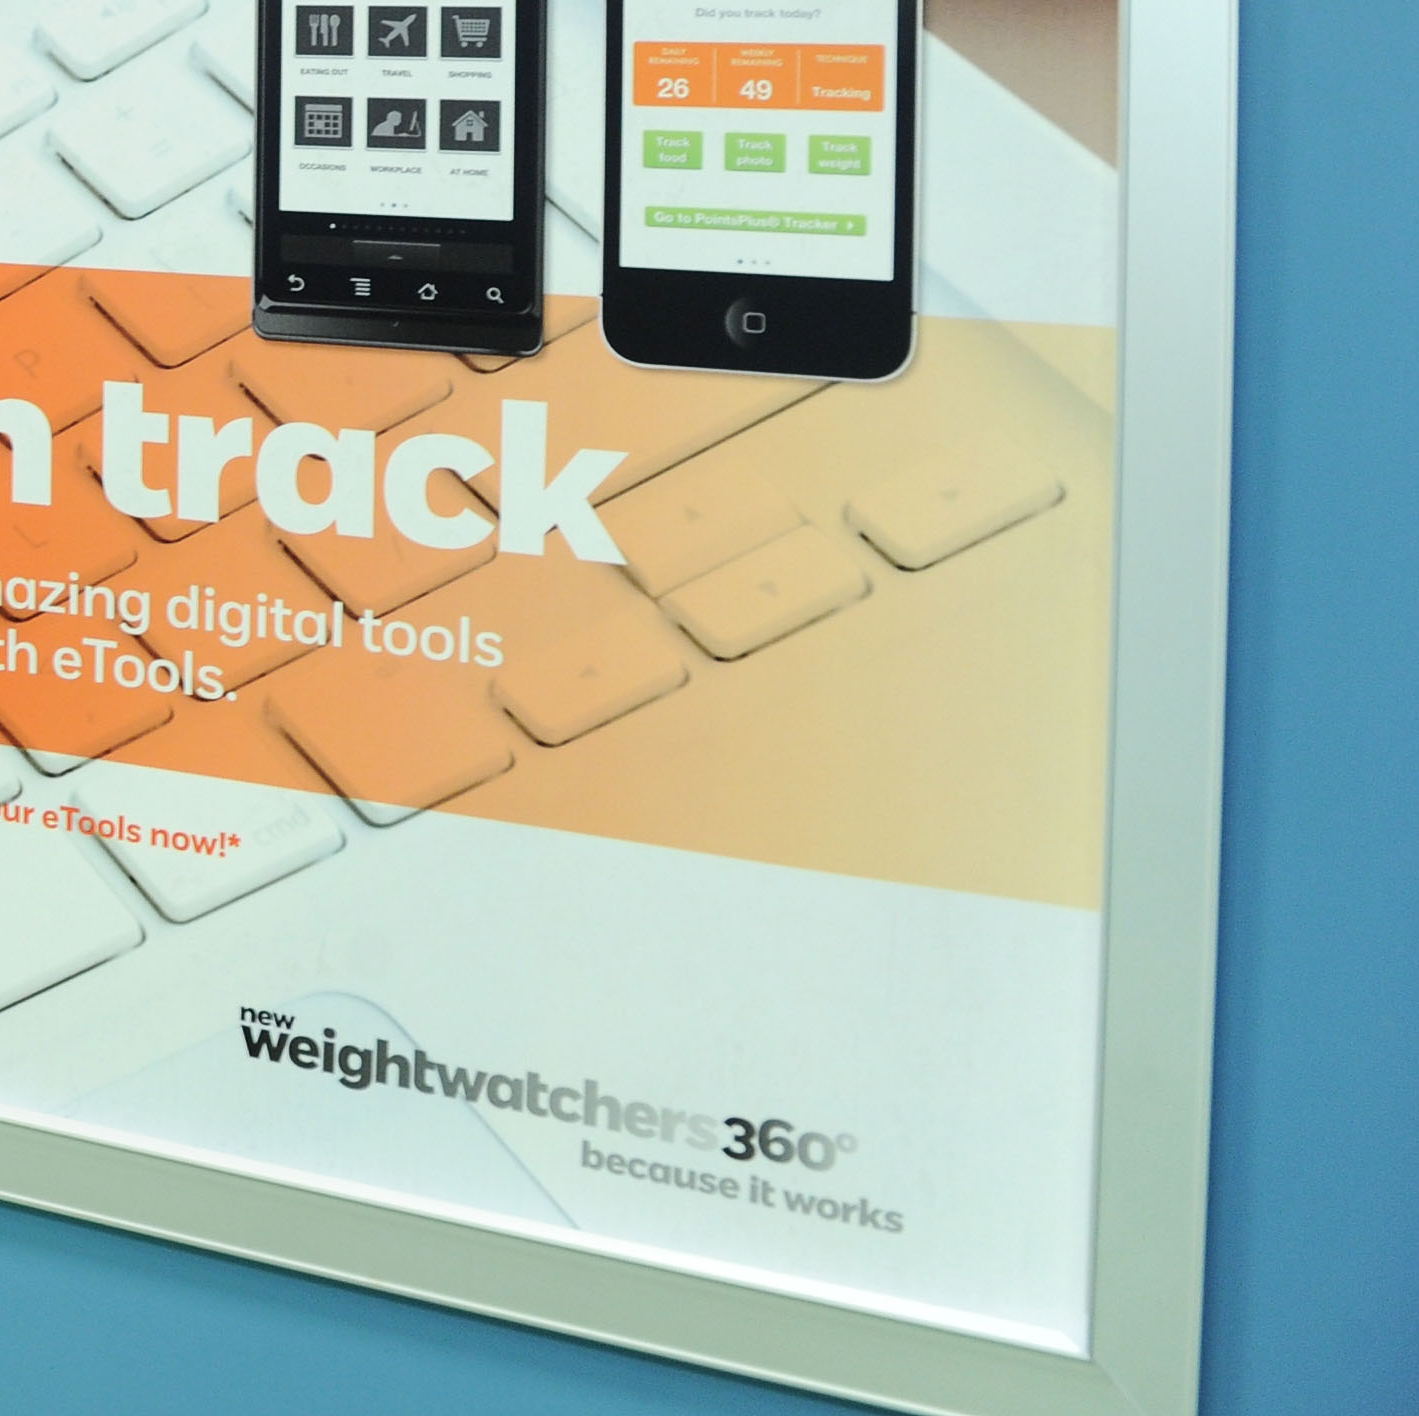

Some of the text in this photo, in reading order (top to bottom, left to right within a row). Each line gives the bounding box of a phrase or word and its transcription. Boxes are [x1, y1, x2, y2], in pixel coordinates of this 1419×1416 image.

[657, 78, 690, 98] 26
[740, 79, 773, 100] 49
[812, 86, 871, 101] Tracking
[654, 212, 673, 223] Go
[677, 212, 692, 224] to
[784, 216, 838, 230] Tracker
[102, 380, 629, 566] track
[166, 585, 344, 649] digital
[358, 608, 505, 668] tools
[52, 637, 238, 702] eTools.
[42, 805, 142, 844] eTools
[240, 1005, 295, 1031] new
[580, 1140, 904, 1235] because it works
